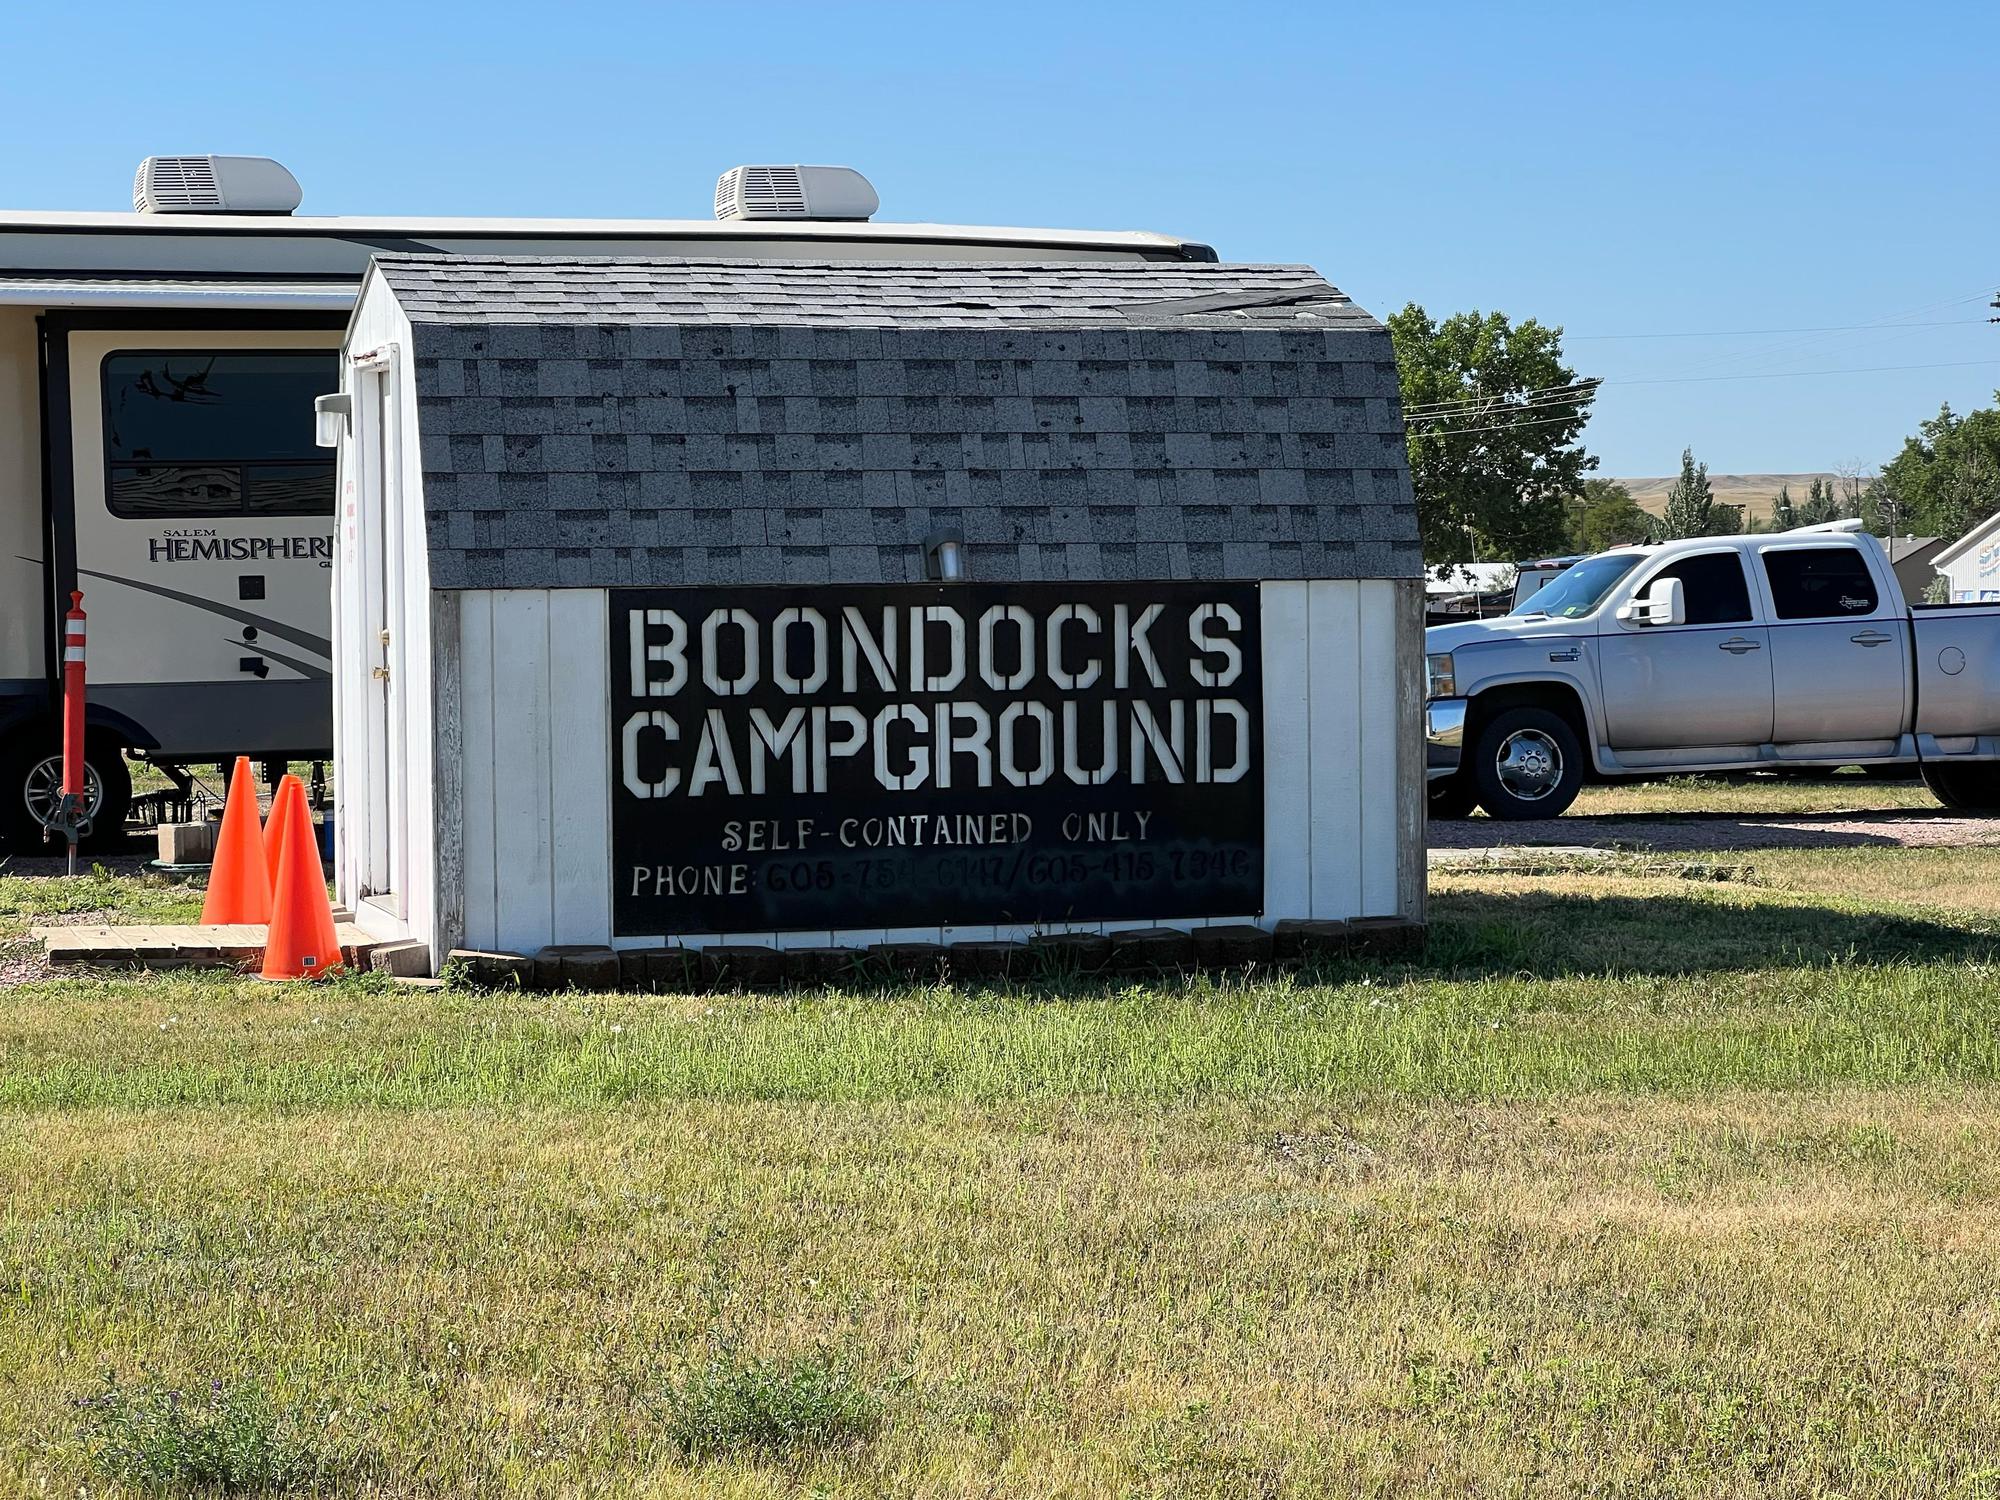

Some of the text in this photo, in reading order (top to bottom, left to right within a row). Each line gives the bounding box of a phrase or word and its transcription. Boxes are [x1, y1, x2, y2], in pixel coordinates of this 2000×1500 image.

[163, 529, 216, 537] SALEM
[628, 603, 1242, 698] BOONDOCKS
[622, 698, 1250, 799] CAMPGROUND
[721, 811, 1152, 851] SELF-CONTAINED ONLY
